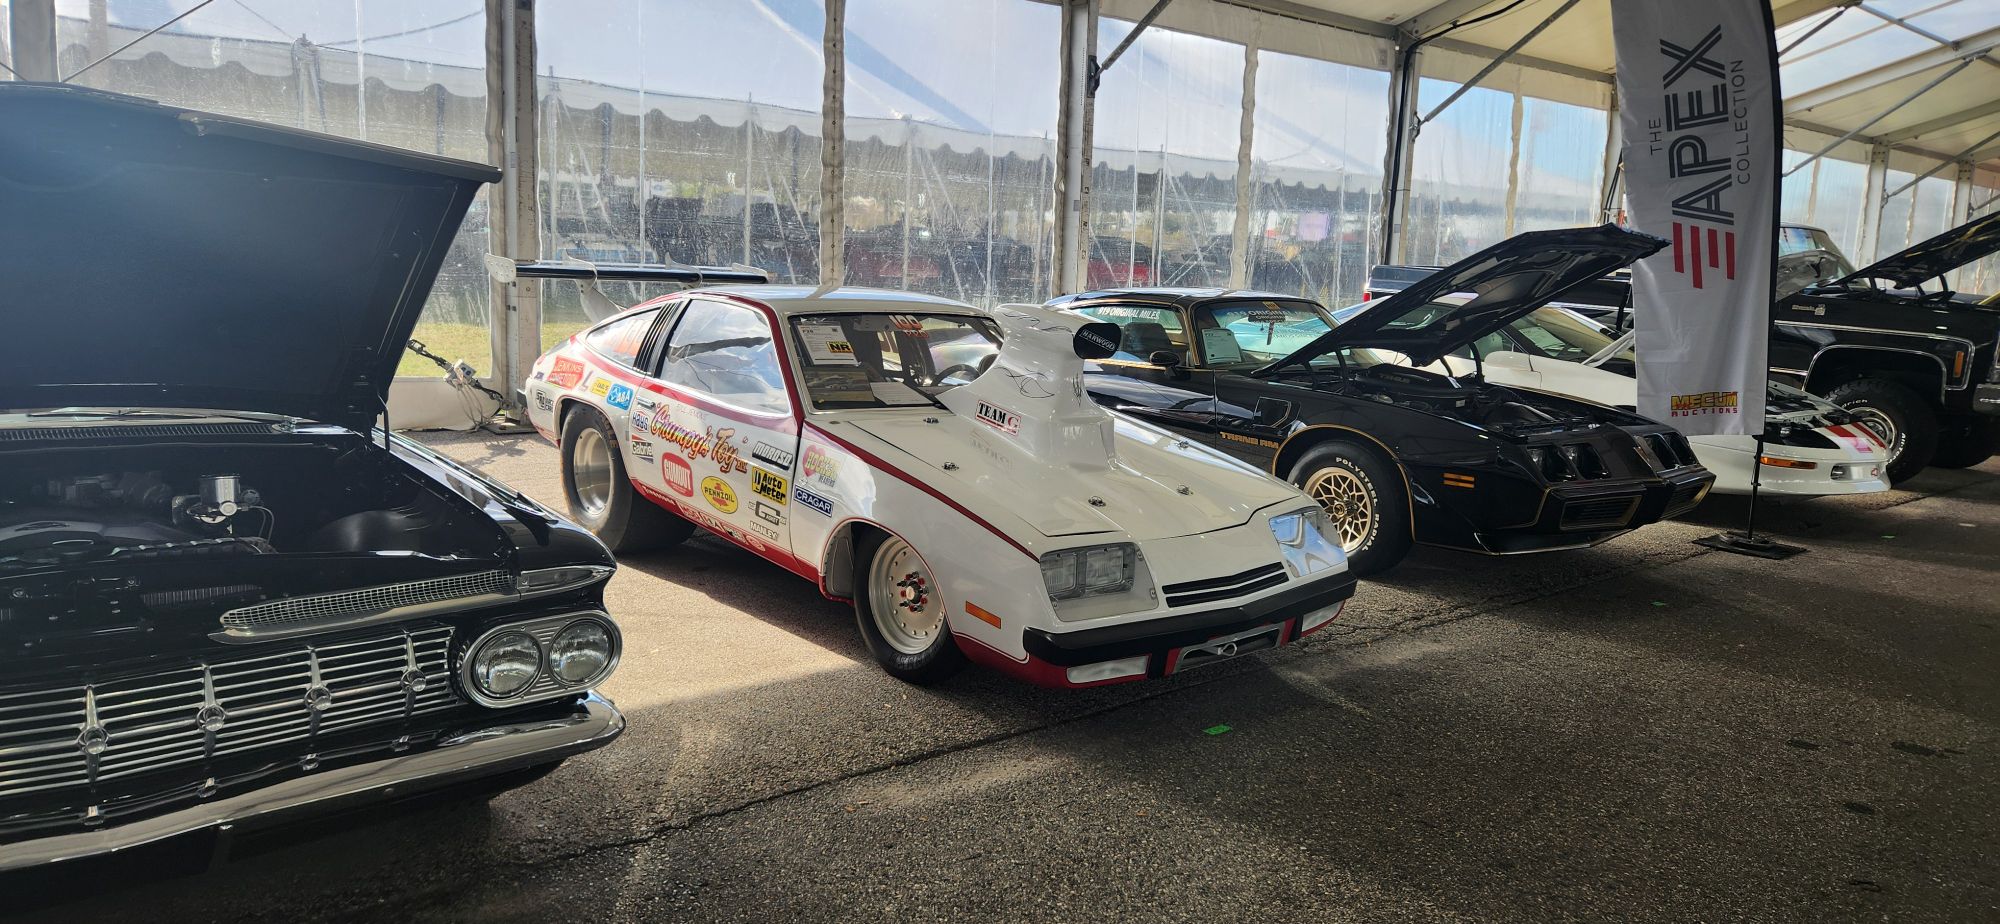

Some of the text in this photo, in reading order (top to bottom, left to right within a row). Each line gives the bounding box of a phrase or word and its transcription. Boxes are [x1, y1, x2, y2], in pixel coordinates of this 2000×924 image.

[1660, 24, 1735, 225] APEX
[1730, 60, 1750, 185] COLLECTION
[1649, 118, 1662, 155] THE
[888, 314, 923, 330] 100
[1098, 306, 1160, 320] 919 ORIGINAL MILES
[830, 342, 851, 351] NR
[1082, 329, 1116, 352] HARWOOD
[1671, 391, 1738, 411] MECUM
[1671, 407, 1738, 417] AUCTIONS
[978, 402, 1006, 424] TEAM
[1007, 416, 1019, 428] G
[632, 441, 653, 457] Gabriel
[711, 428, 739, 474] Toy
[1219, 431, 1279, 449] TRANS AM
[752, 441, 792, 468] MOROSO
[664, 459, 691, 491] GUMOUT
[762, 472, 783, 490] Auto
[1336, 456, 1378, 507] POLYSTEEL
[704, 487, 735, 503] PENNZOIL
[761, 483, 786, 501] Meter
[795, 489, 832, 514] CRAGAR
[1362, 513, 1379, 551] RADIAL
